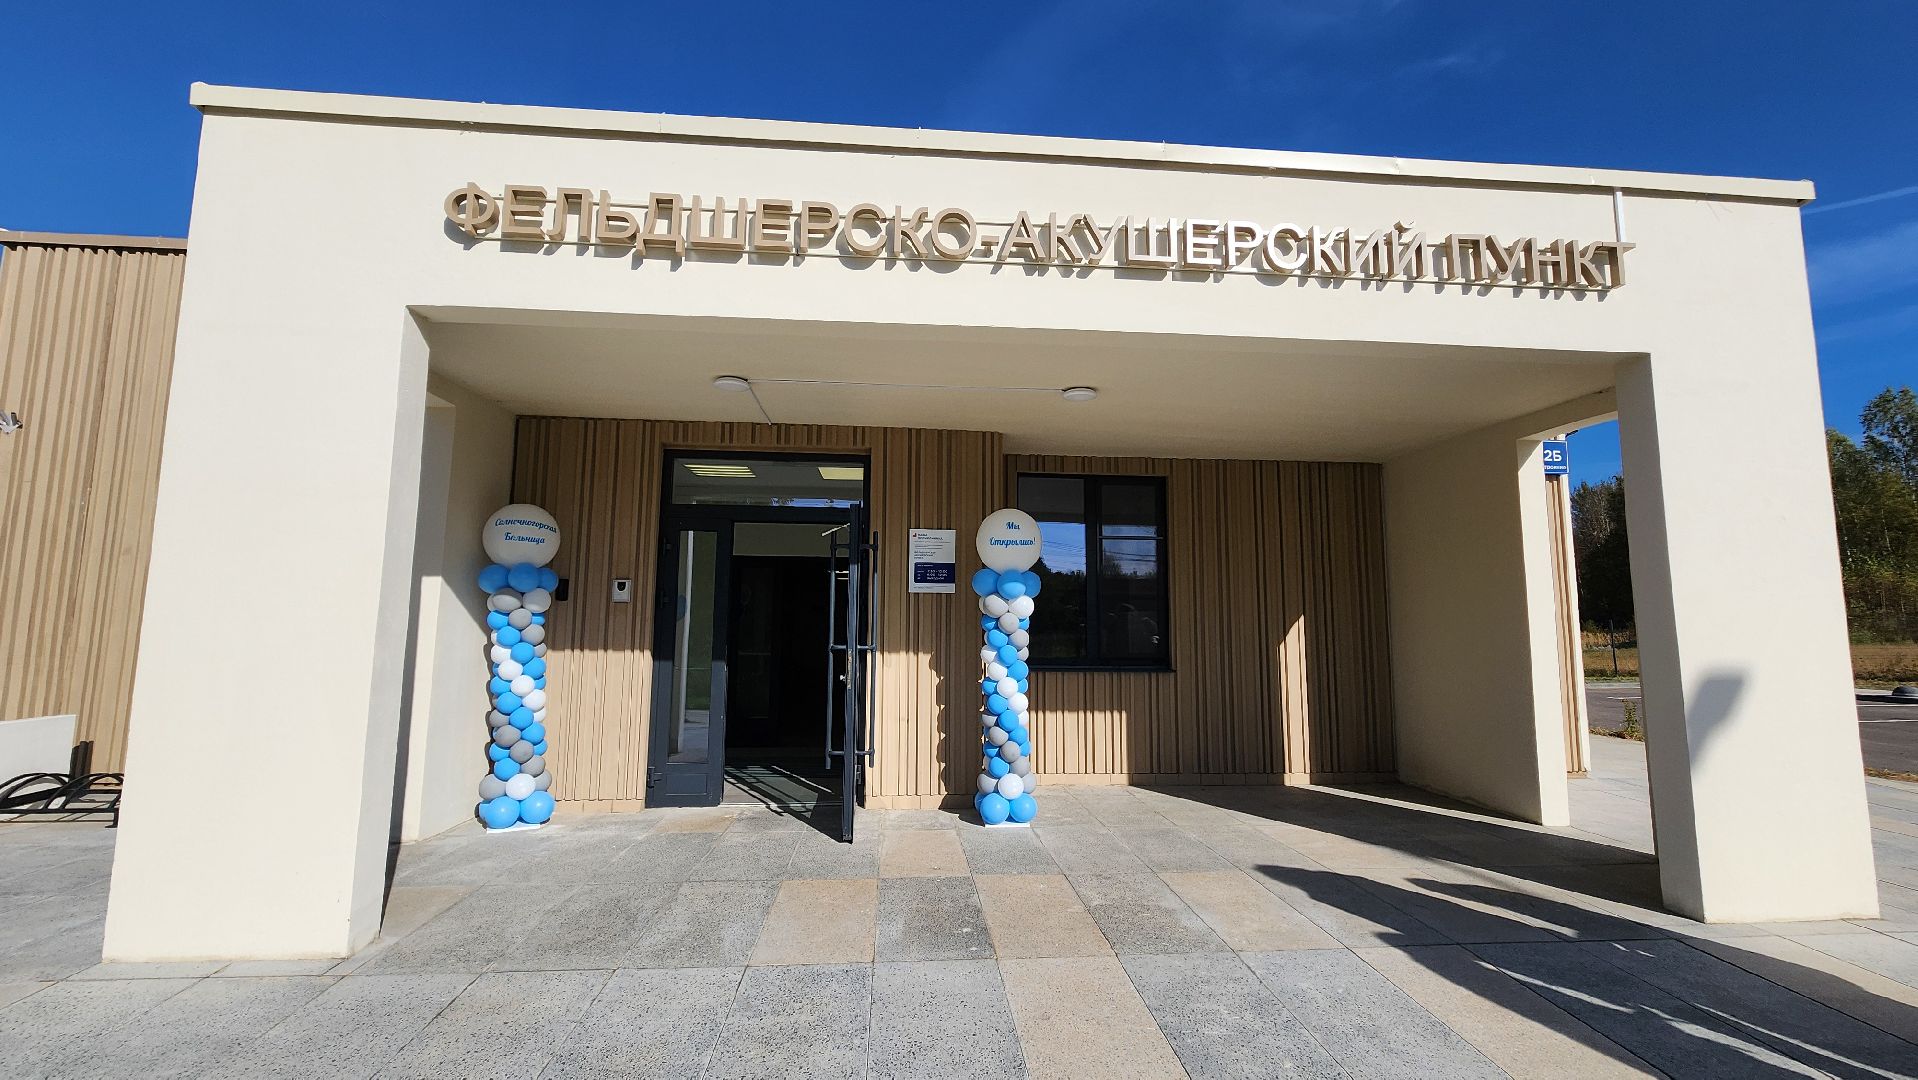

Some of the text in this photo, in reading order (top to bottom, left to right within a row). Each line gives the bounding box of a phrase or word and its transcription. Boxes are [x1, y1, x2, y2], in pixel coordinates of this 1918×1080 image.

[444, 181, 1637, 290] ФЕЛЬДШЕРСКО-АКУШЕРСКИЙ ПУНКТ
[1005, 521, 1021, 530] Мы
[504, 531, 546, 545] Больница
